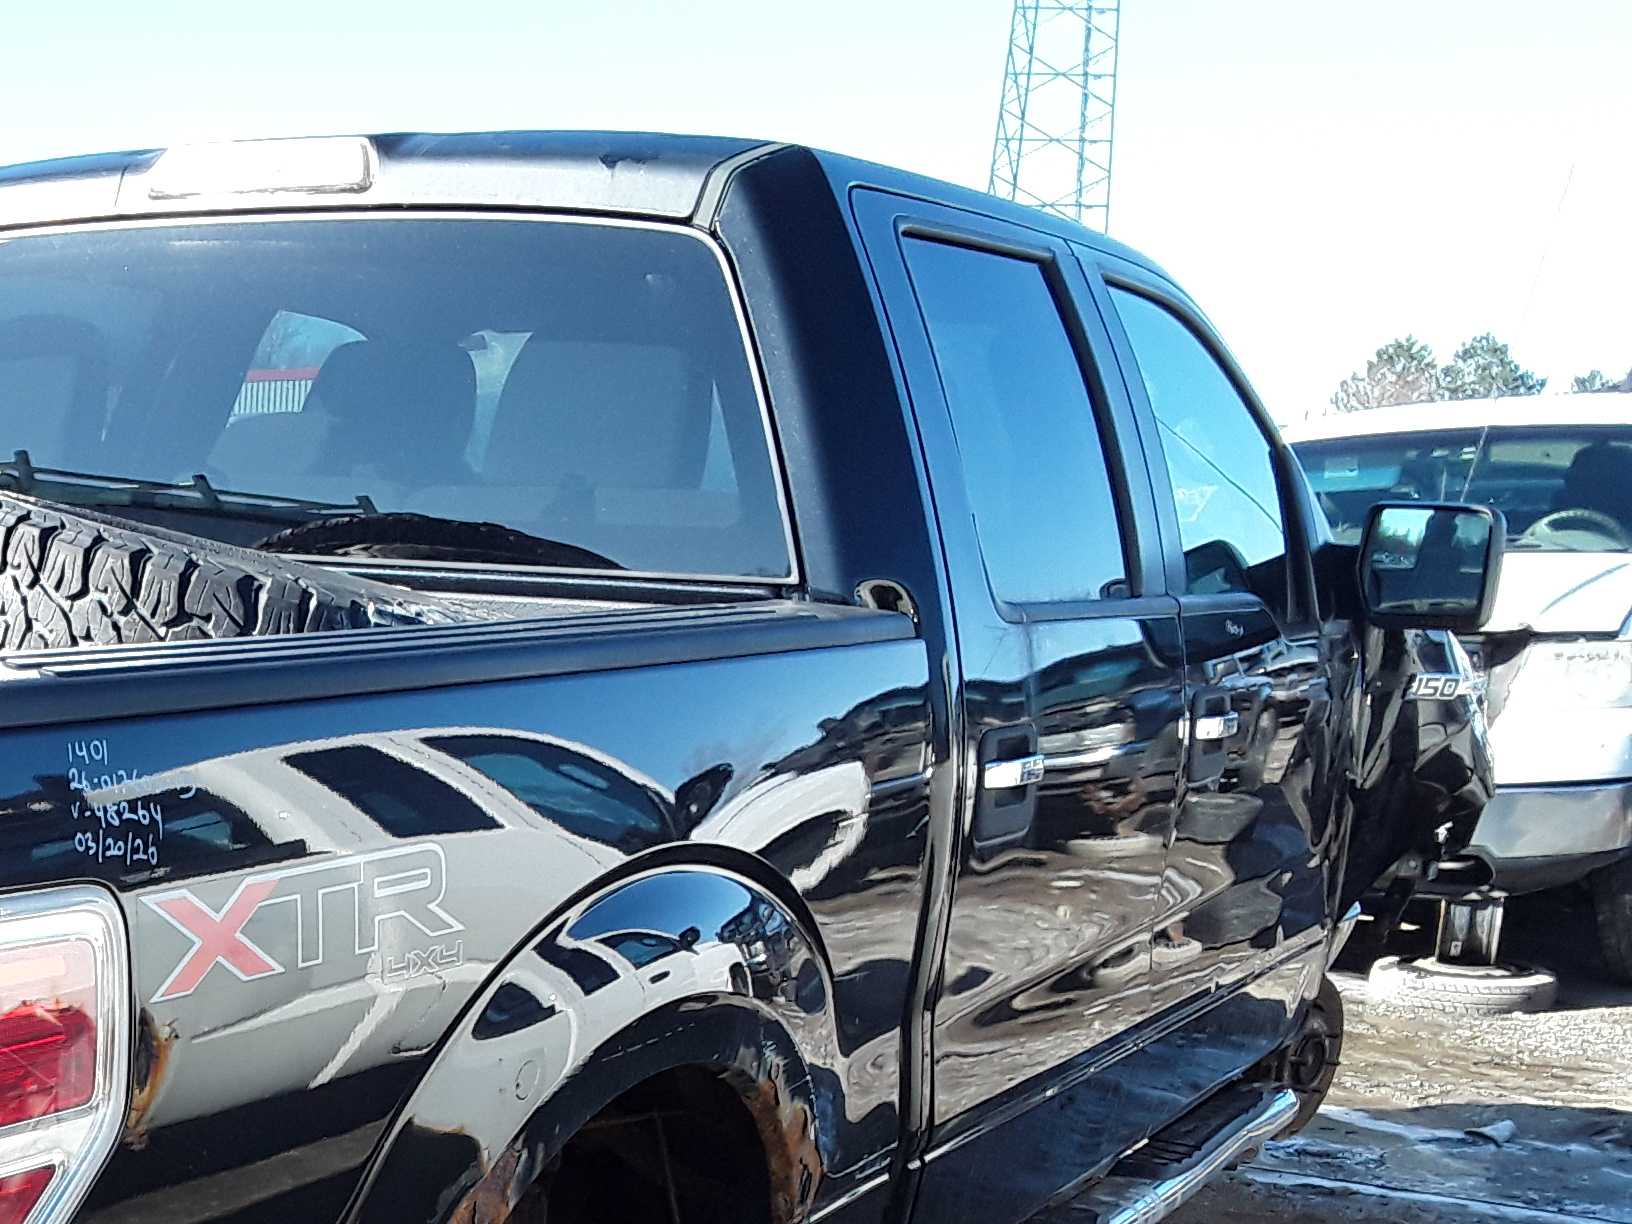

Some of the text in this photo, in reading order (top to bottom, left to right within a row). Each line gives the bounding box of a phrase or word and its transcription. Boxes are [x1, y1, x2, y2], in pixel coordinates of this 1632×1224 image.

[68, 739, 108, 766] 1401
[74, 829, 158, 866] 03/20/26
[136, 841, 466, 1004] XTR
